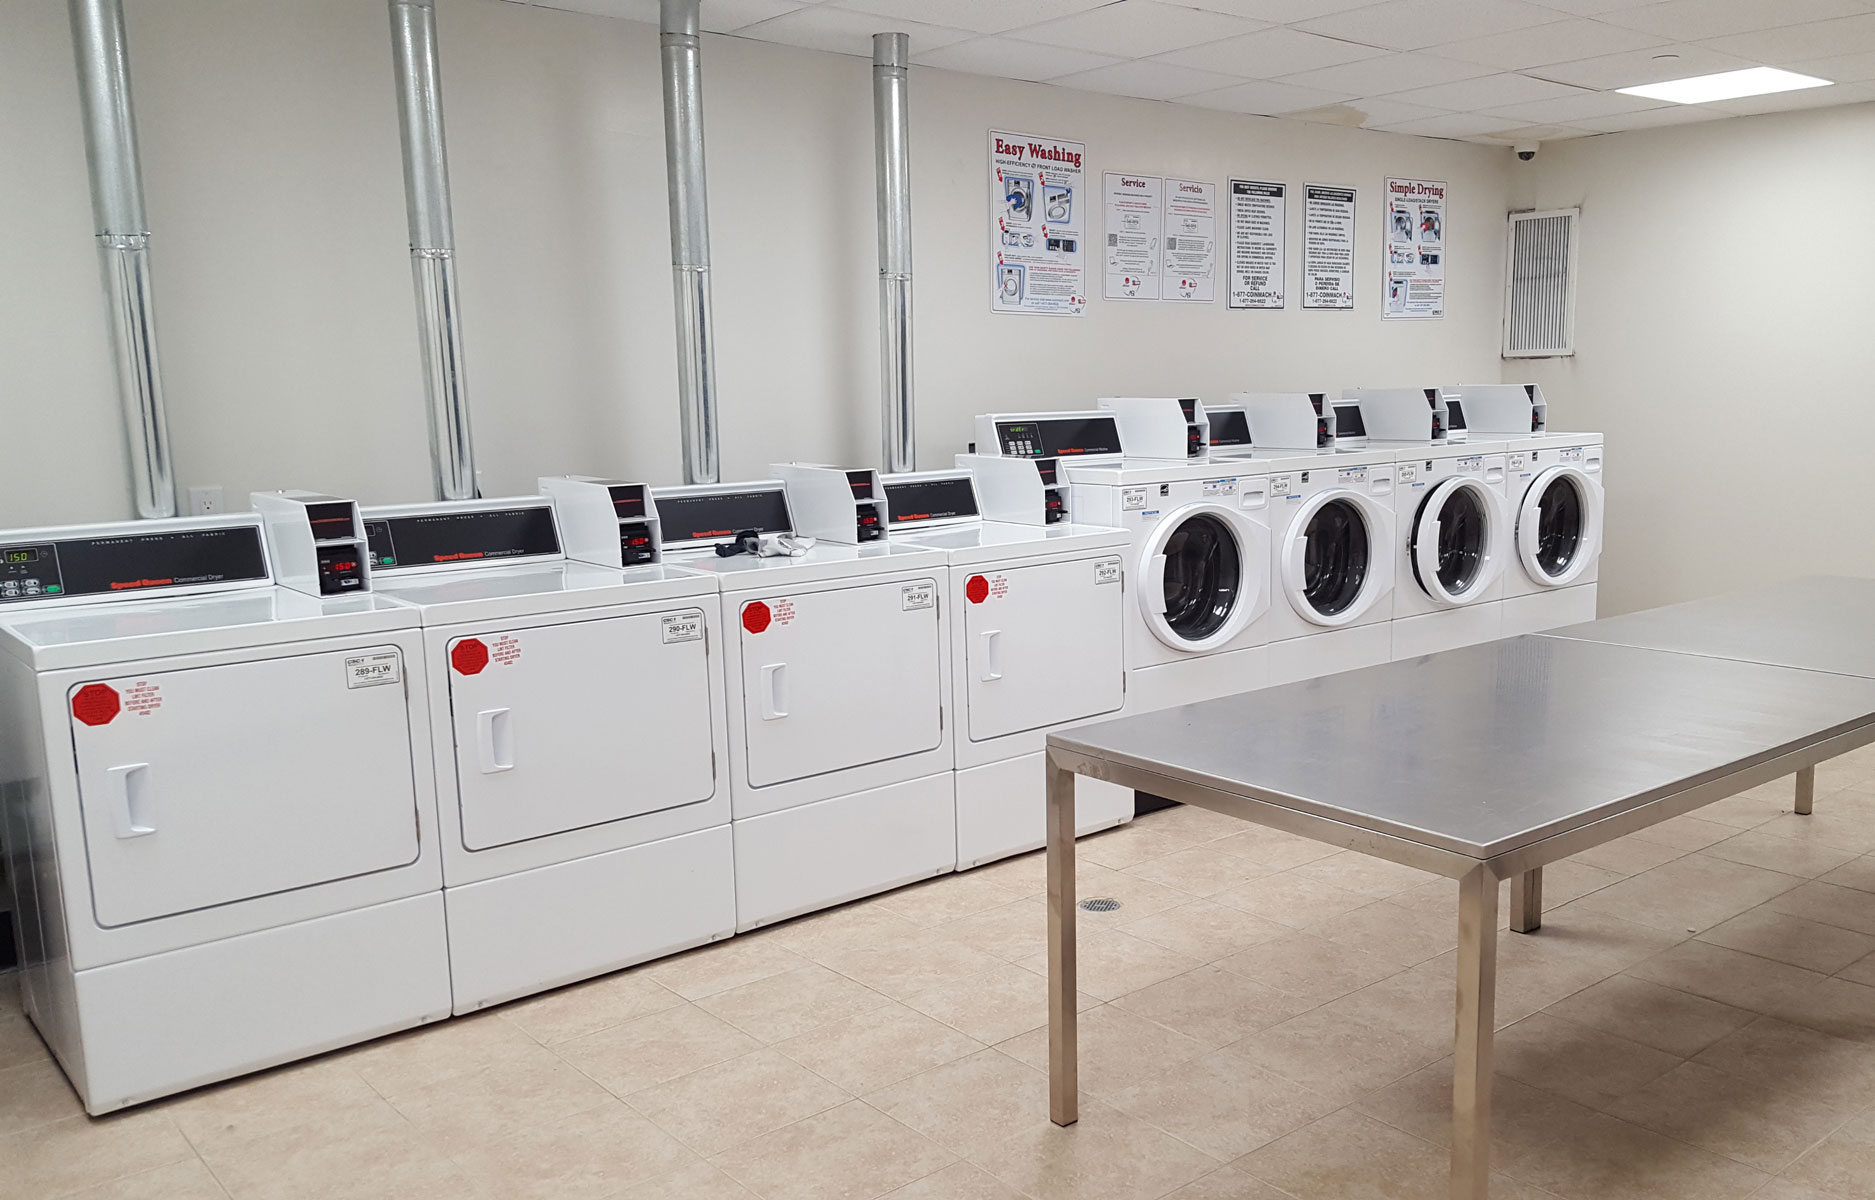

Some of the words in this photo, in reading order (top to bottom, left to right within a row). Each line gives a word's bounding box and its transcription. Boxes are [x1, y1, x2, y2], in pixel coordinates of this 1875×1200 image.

[995, 138, 1025, 160] Easy
[1028, 143, 1081, 168] Washing
[1122, 178, 1146, 188] Service
[1179, 183, 1202, 193] Servicio
[1390, 181, 1415, 197] Simple
[1417, 184, 1444, 199] Drying
[10, 552, 27, 561] 150
[669, 624, 696, 632] 290-FLW
[355, 665, 391, 675] 289-FLW
